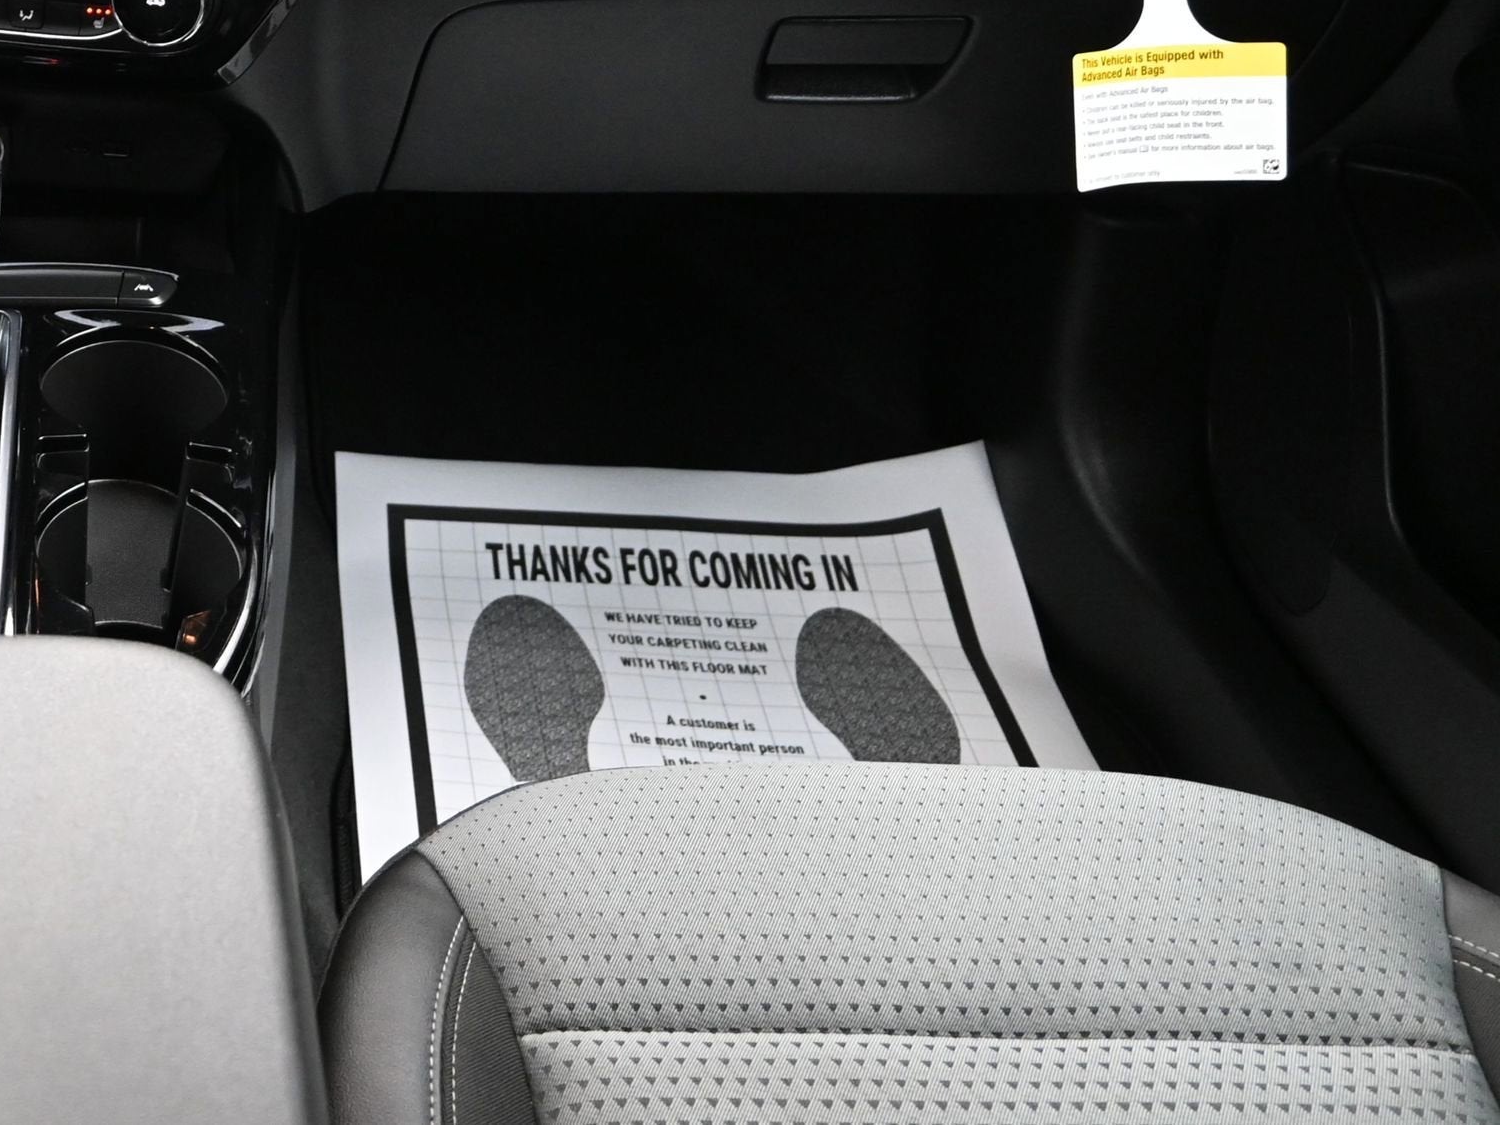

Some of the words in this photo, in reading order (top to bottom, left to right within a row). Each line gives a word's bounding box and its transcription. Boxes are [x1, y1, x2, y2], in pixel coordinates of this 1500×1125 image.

[1082, 58, 1099, 70] This
[1100, 54, 1133, 67] Vehicle
[1135, 52, 1143, 63] is
[1146, 50, 1195, 64] Equipped
[1199, 49, 1224, 60] with
[1082, 67, 1122, 82] Advanced
[1125, 65, 1137, 77] Air
[1141, 64, 1165, 77] Bags
[485, 542, 613, 585] THANKS
[620, 547, 683, 587] FOR
[688, 549, 816, 591] COMING
[820, 554, 859, 592] IN
[604, 611, 624, 622] WE
[626, 613, 663, 625] HAVE
[665, 615, 701, 627] TRIED
[705, 617, 723, 628] TO
[725, 618, 758, 629] KEEP
[608, 633, 643, 645] YOUR
[647, 636, 722, 651] CARPETING
[724, 641, 768, 652] CLEAN
[620, 656, 655, 669] WITH
[658, 659, 689, 672] THIS
[692, 661, 736, 675] FLOOR
[738, 664, 768, 675] MAT
[666, 714, 676, 726] A
[679, 717, 739, 731] customer
[743, 719, 756, 732] is
[629, 732, 651, 745] the
[655, 736, 687, 748] most
[691, 736, 755, 752] important
[758, 742, 805, 756] person
[663, 755, 677, 767] in
